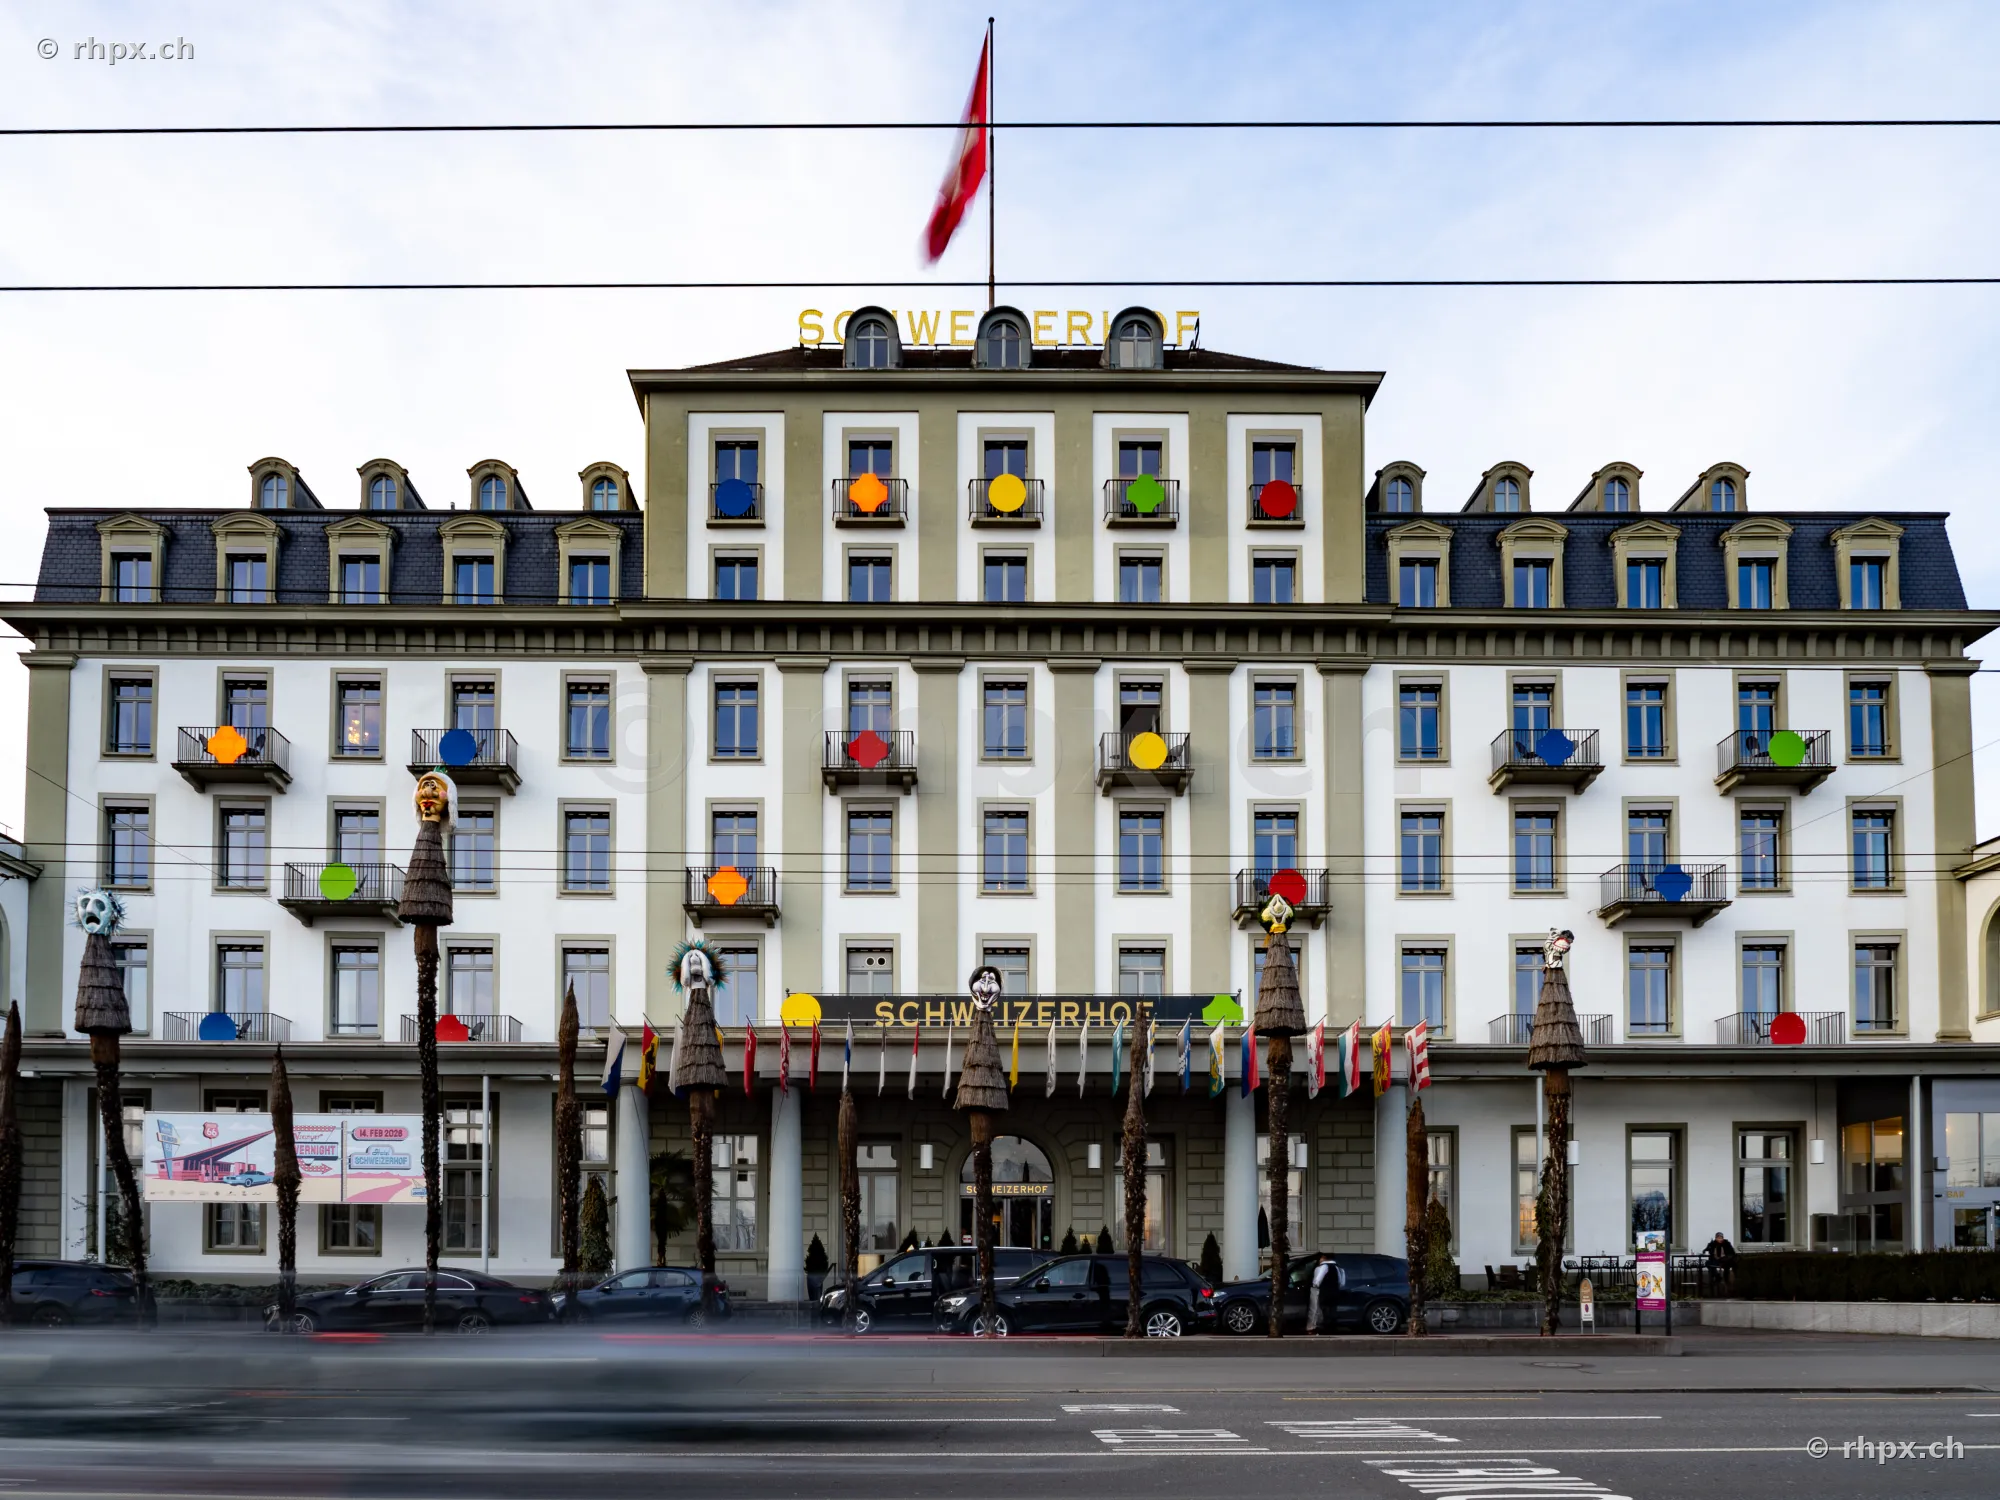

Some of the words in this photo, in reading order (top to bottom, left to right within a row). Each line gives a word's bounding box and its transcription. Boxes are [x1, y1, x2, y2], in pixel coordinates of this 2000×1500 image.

[206, 1128, 217, 1137] 66
[370, 1129, 383, 1138] FEB
[354, 1156, 408, 1165] SCHWEIZERHOF
